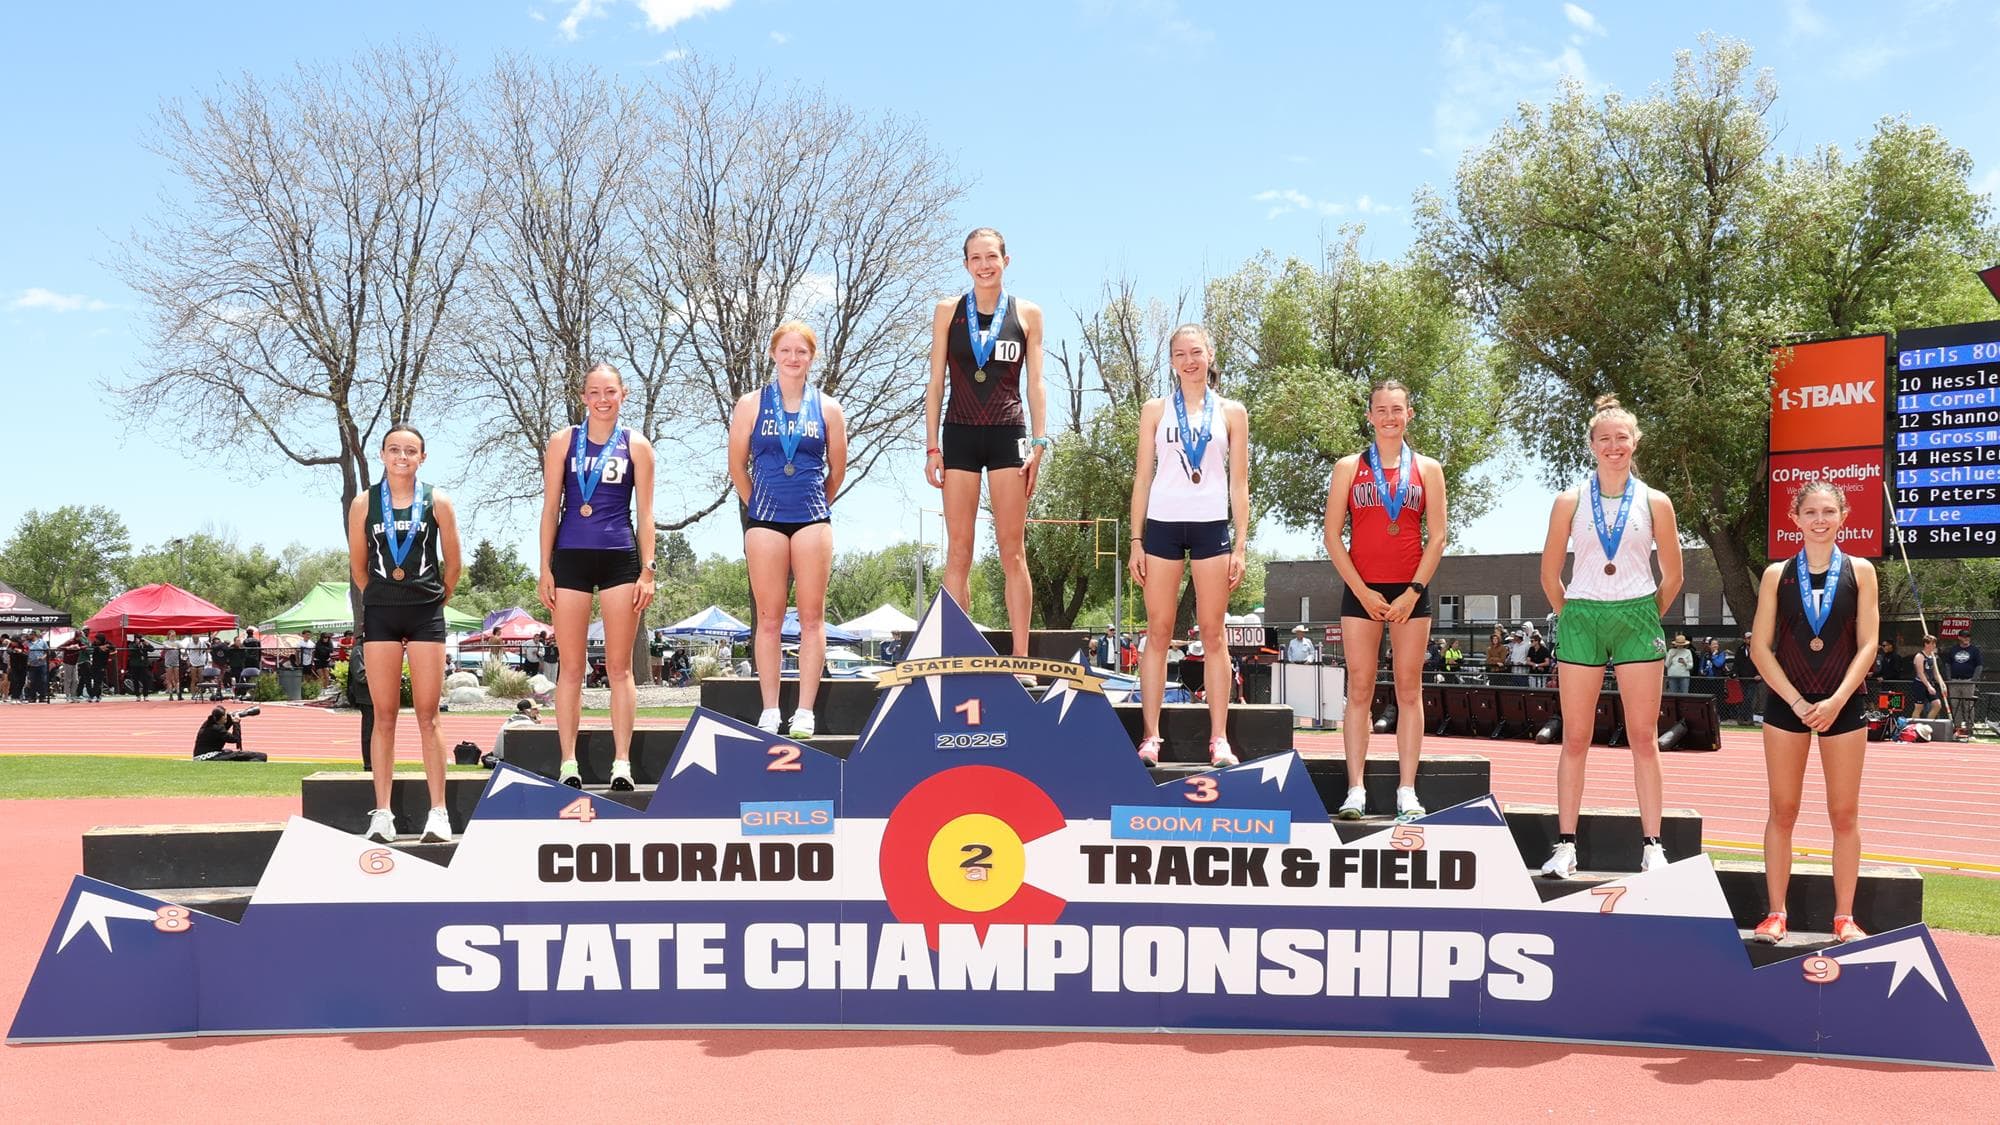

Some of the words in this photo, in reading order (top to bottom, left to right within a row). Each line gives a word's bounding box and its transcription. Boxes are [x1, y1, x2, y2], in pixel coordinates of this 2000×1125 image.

[1000, 342, 1017, 361] 10
[1900, 347, 1958, 366] Girls
[1973, 343, 2000, 360] 80
[1900, 377, 1921, 392] 10
[1932, 370, 1998, 389] Hessle
[1779, 380, 1876, 410] 1STBANK
[1898, 394, 1919, 410] 11
[1930, 388, 2000, 407] Cornel
[1899, 413, 1920, 428] 12
[1932, 410, 2000, 426] Shanno
[1898, 432, 1918, 447] 13
[1929, 430, 2000, 445] Grossm
[606, 458, 619, 481] 3
[1897, 451, 1918, 466] 14
[1772, 468, 1790, 482] CO
[1792, 466, 1821, 482] Prep
[1822, 463, 1881, 482] Spotlight
[1897, 469, 1918, 485] 15
[1898, 488, 1919, 503] 16
[1930, 488, 1996, 502] Peters
[1897, 508, 1918, 523] 17
[1928, 509, 1961, 522] Lee
[1898, 529, 1918, 544] 18
[1929, 526, 1996, 545] Sheleg
[901, 659, 964, 673] STATE
[970, 659, 1078, 675] CHAMPION
[954, 698, 982, 726] 1
[936, 732, 1007, 748] 2025
[766, 744, 803, 772] 2
[1183, 776, 1221, 802] 3
[558, 796, 597, 823] 4
[742, 809, 829, 826] GIRLS
[1129, 815, 1201, 833] 800M
[1211, 816, 1275, 835] RUN
[1389, 826, 1425, 852] 5
[358, 848, 394, 875] 6
[537, 842, 835, 882] COLORADO
[959, 844, 993, 869] 2
[1079, 845, 1270, 888] TRACK
[1280, 848, 1320, 888] &
[1329, 848, 1477, 890] FIELD
[964, 866, 989, 881] a
[1590, 886, 1628, 914] 7
[153, 905, 192, 933] 8
[435, 922, 727, 993] STATE
[744, 922, 1556, 1001] CHAMPIONSHIPS
[1801, 954, 1842, 984] 9
